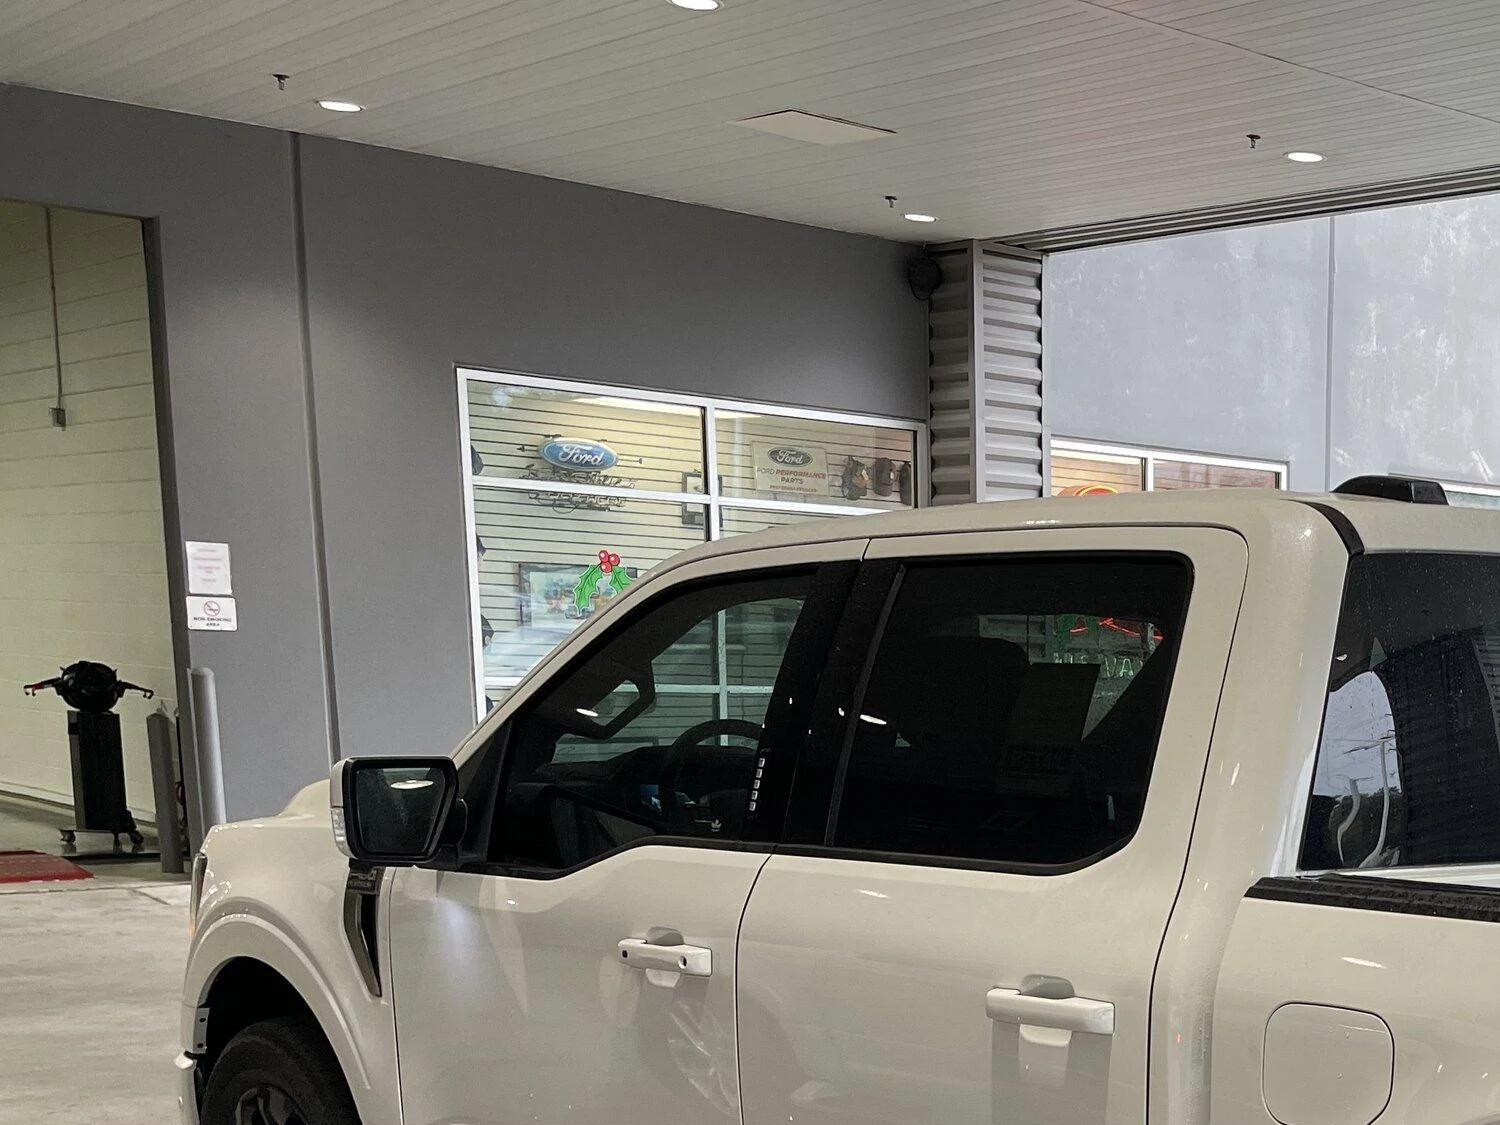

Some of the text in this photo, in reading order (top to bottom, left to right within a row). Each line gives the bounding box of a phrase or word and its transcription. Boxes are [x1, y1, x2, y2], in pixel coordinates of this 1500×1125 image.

[558, 443, 605, 465] Ford
[776, 449, 804, 464] Ford
[757, 467, 827, 480] FORD PERFORMANCE
[780, 476, 804, 485] PARTS
